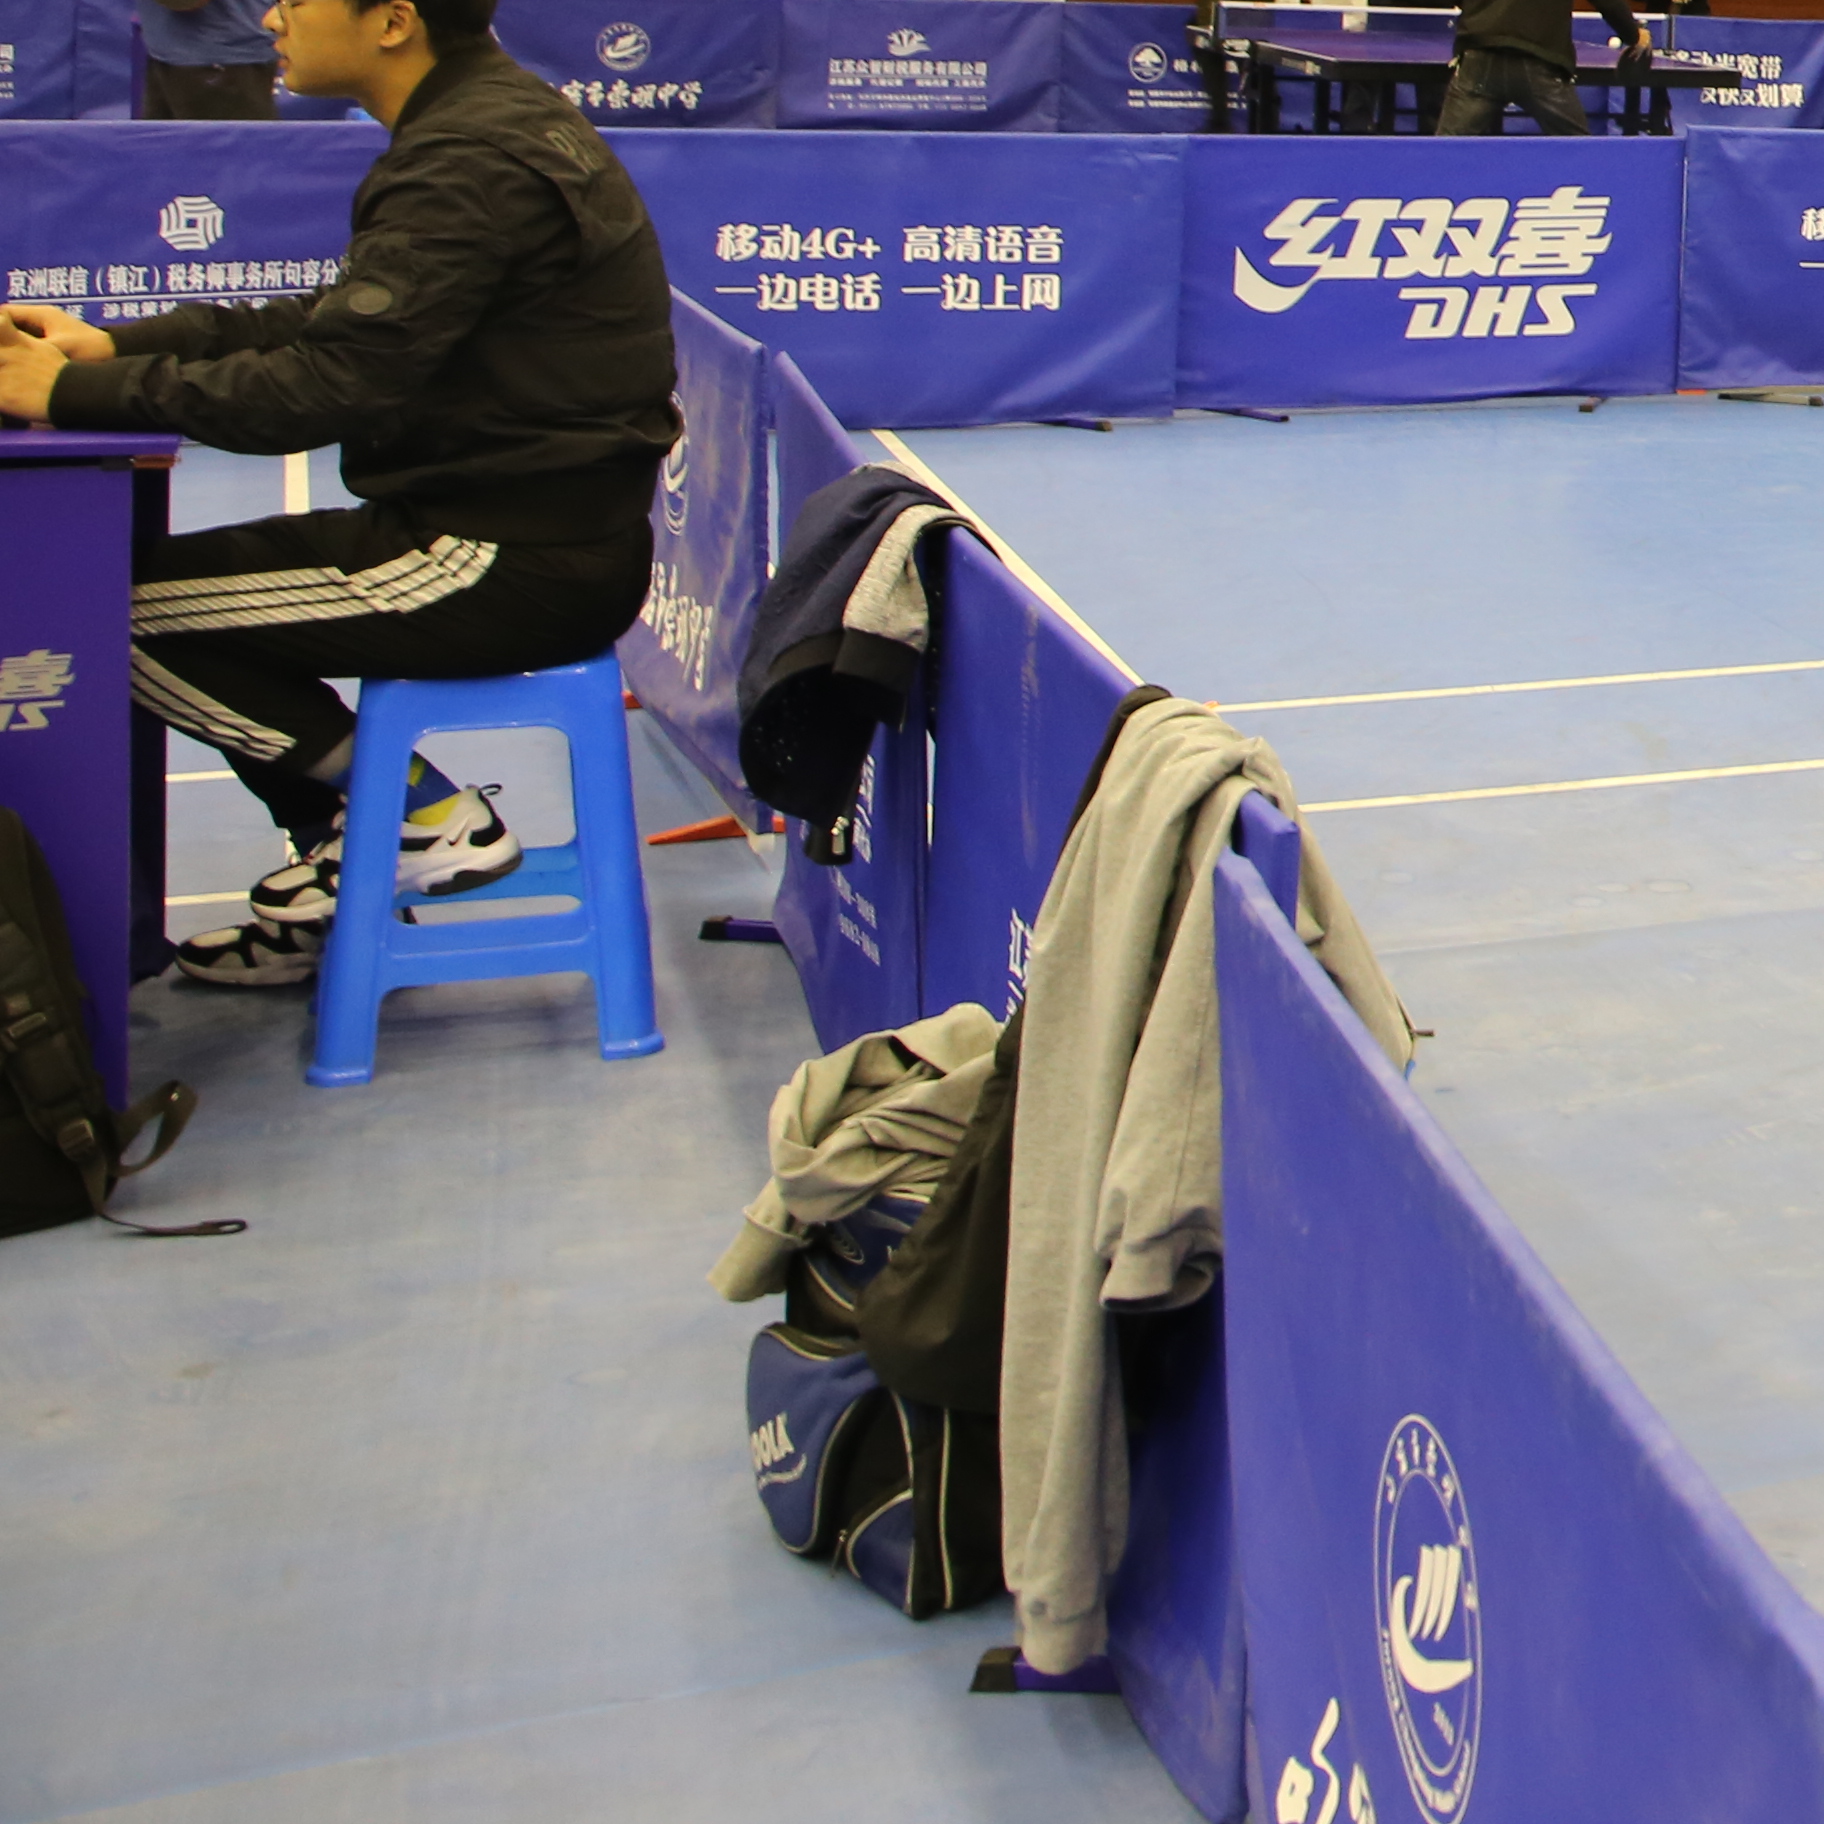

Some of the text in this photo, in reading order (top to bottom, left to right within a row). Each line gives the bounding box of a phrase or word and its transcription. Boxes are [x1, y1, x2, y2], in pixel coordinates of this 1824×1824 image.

[715, 222, 1064, 264] 移动4G+ 高清语音
[1238, 185, 1613, 290] 红双喜
[7, 257, 348, 298] 京洲联信（镇江）税务师事务所句容分
[715, 273, 1062, 311] 一边电话 一边上网
[1399, 283, 1598, 339] DHS
